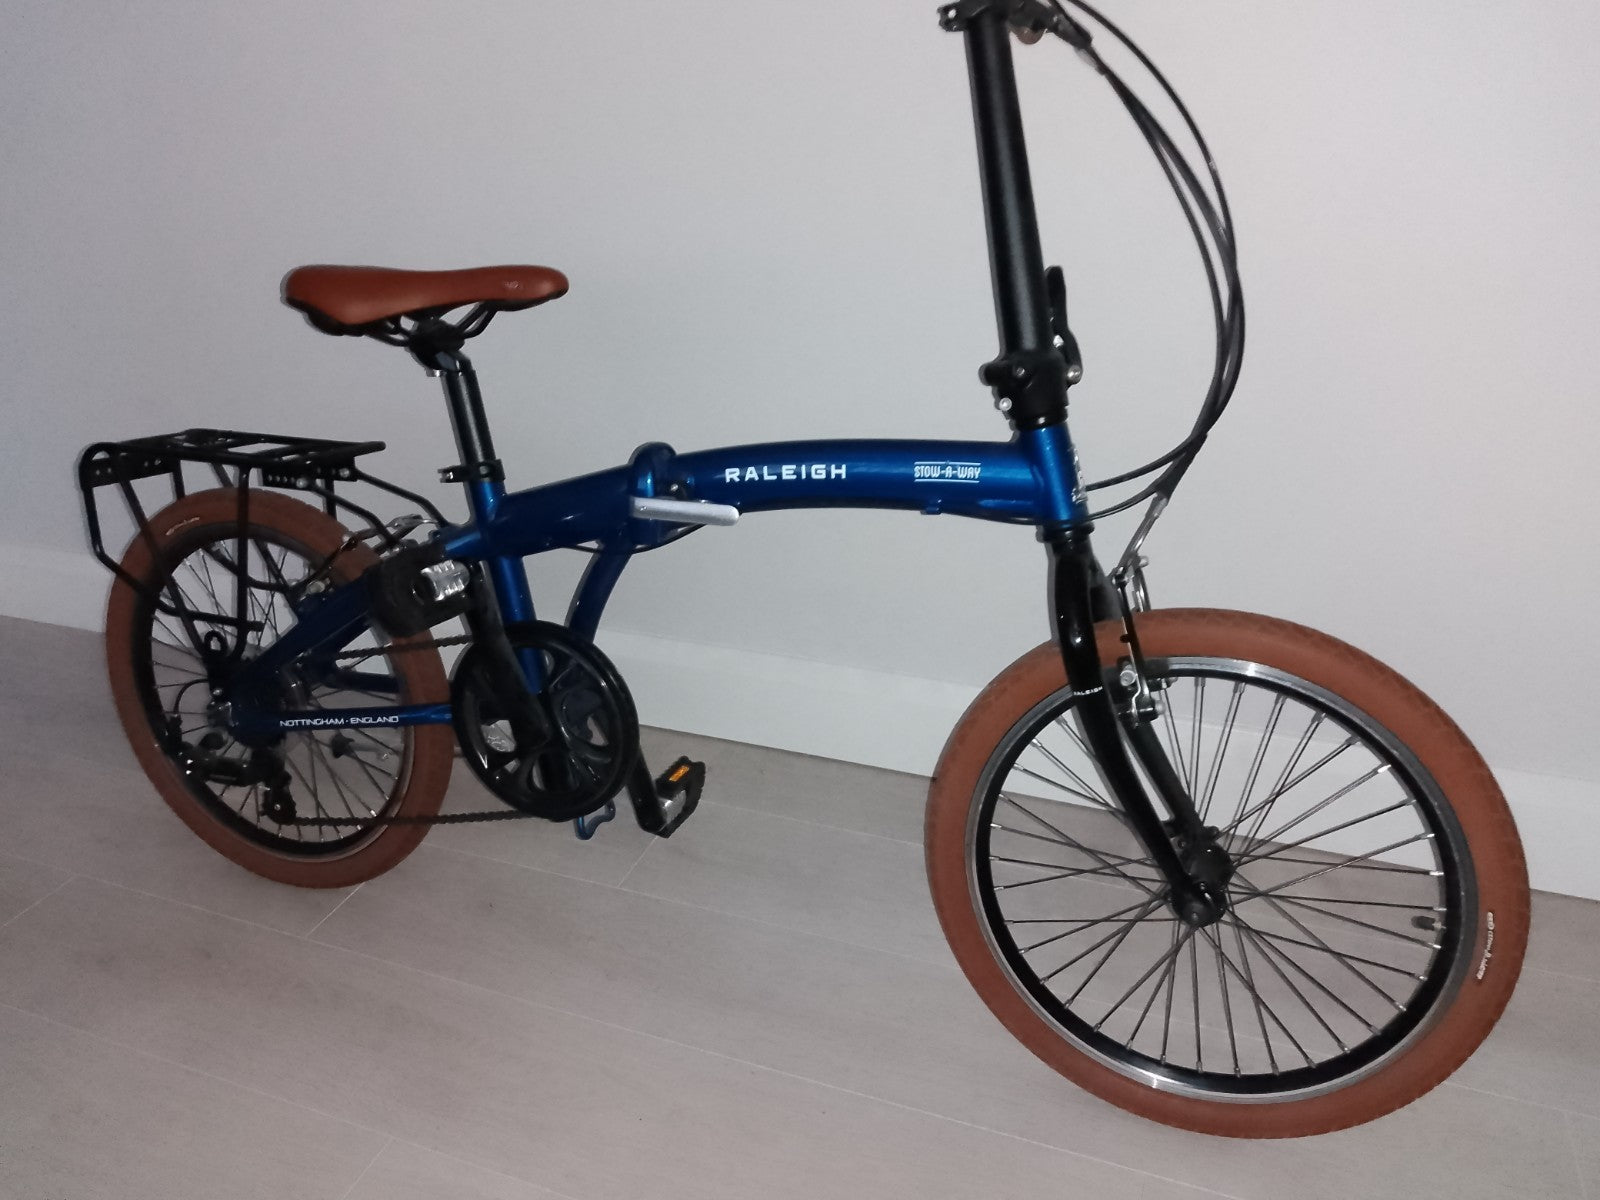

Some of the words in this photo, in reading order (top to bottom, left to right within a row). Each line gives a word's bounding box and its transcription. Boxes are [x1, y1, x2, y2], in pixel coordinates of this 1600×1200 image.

[724, 464, 847, 483] RALEIGH
[914, 464, 981, 480] STOW-A-WAY
[279, 718, 345, 727] NOTTINGHAM
[350, 715, 399, 724] ENGLAND
